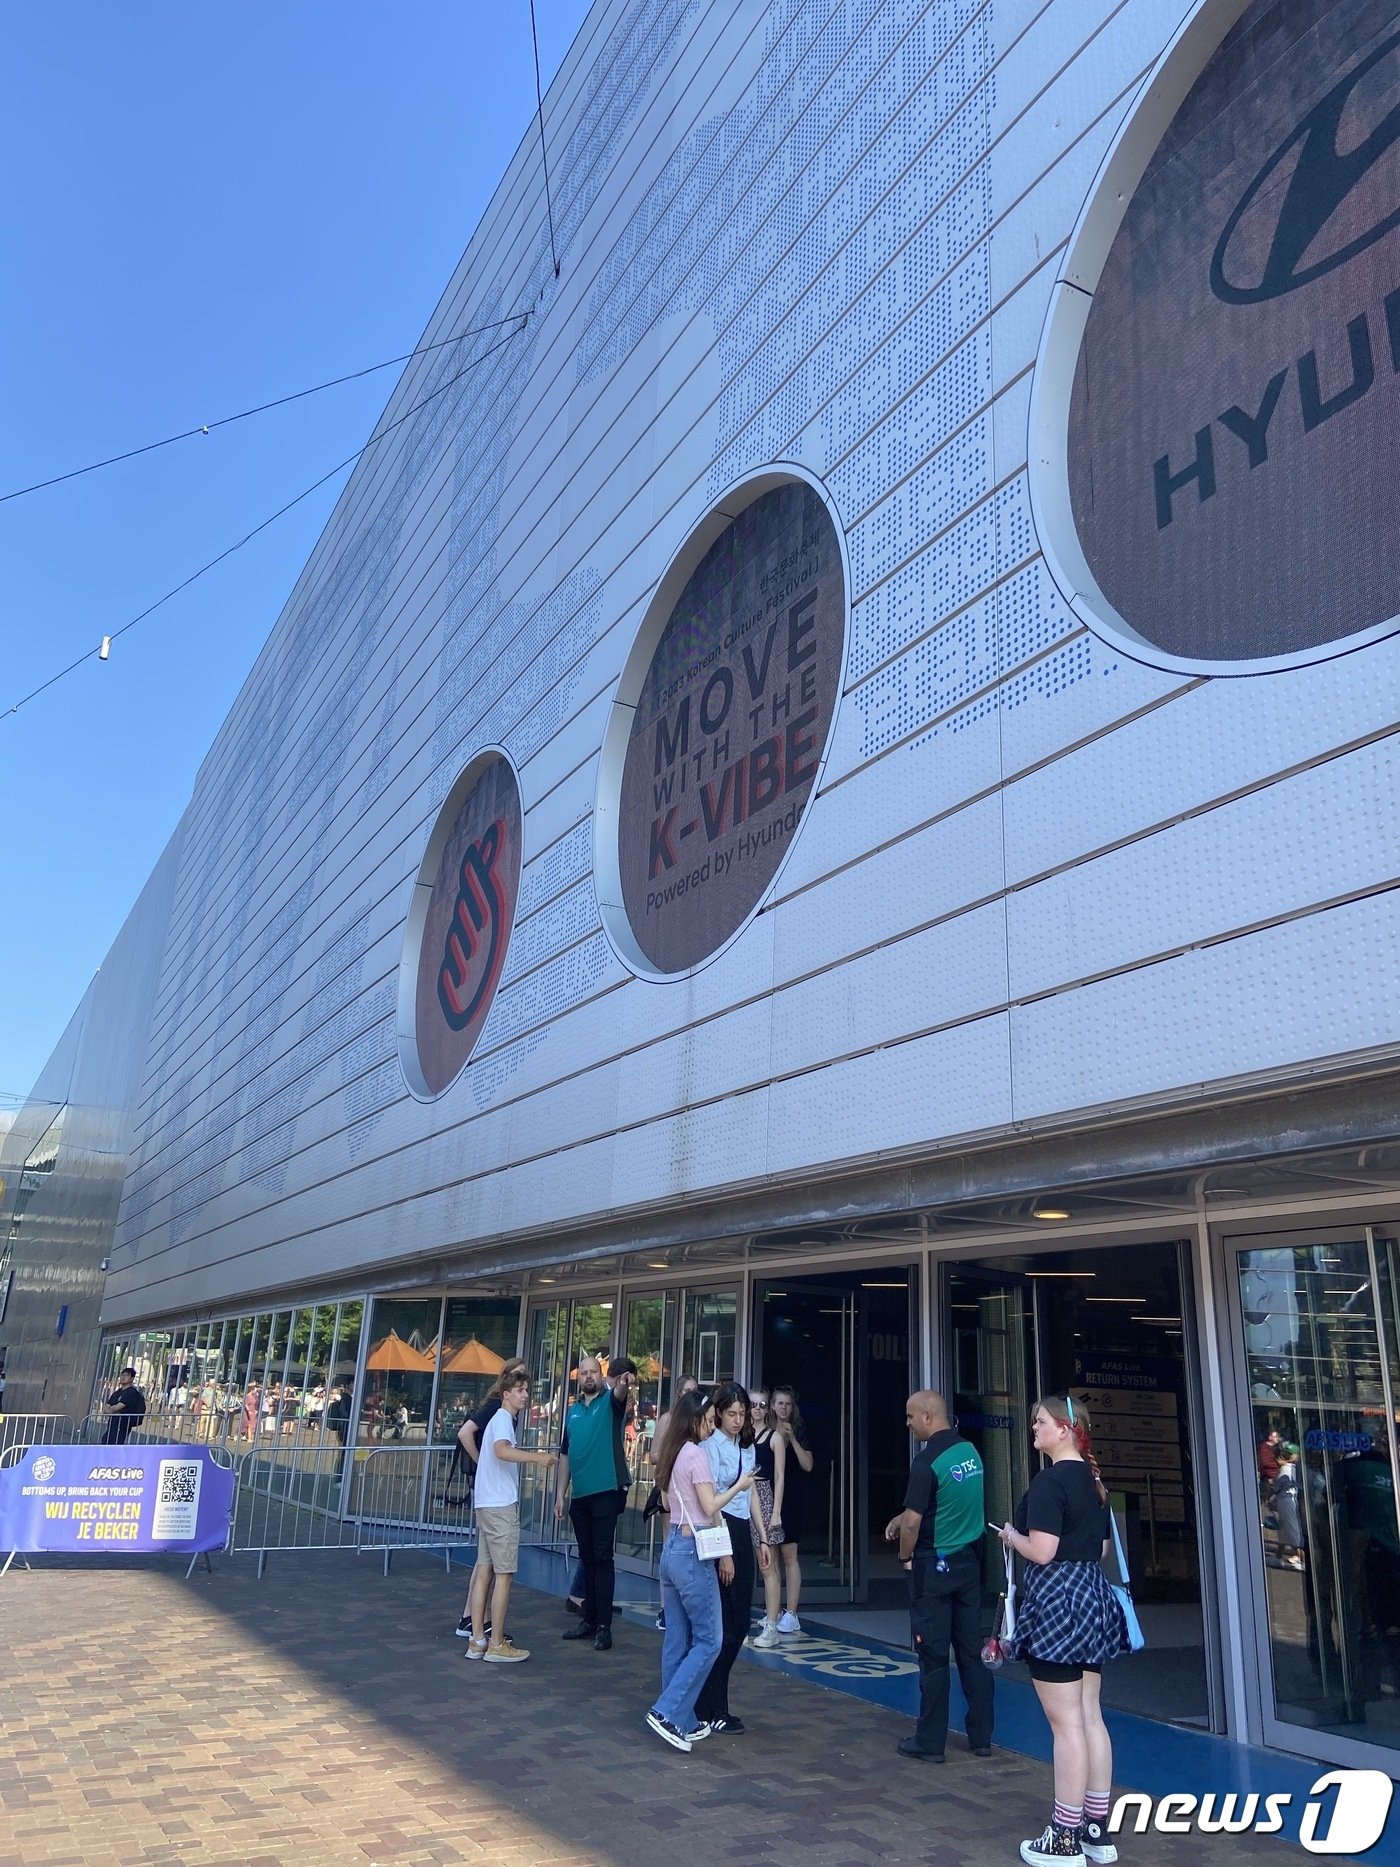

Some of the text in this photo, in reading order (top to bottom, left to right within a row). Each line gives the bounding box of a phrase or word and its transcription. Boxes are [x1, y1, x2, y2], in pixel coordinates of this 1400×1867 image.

[1152, 286, 1400, 531] HYU
[687, 646, 721, 681] Korean
[723, 609, 763, 650] Culture
[654, 586, 819, 778] MOVE
[653, 662, 817, 812] WITH THE
[648, 703, 820, 881] K-VIBE
[645, 856, 710, 916] Powered
[714, 847, 734, 878] by
[1086, 1372, 1158, 1388] RETURN SYSTEM
[88, 1467, 144, 1480] AFAS Live
[960, 1458, 977, 1473] TSC
[22, 1486, 55, 1496] BOTTOMS
[67, 1487, 89, 1496] BRING
[90, 1487, 108, 1496] BACK
[109, 1487, 128, 1496] YOUR
[128, 1487, 144, 1496] CUP
[45, 1502, 141, 1520] WIJ RECYCLEN
[76, 1521, 93, 1540] JE
[94, 1522, 139, 1540] BEKER
